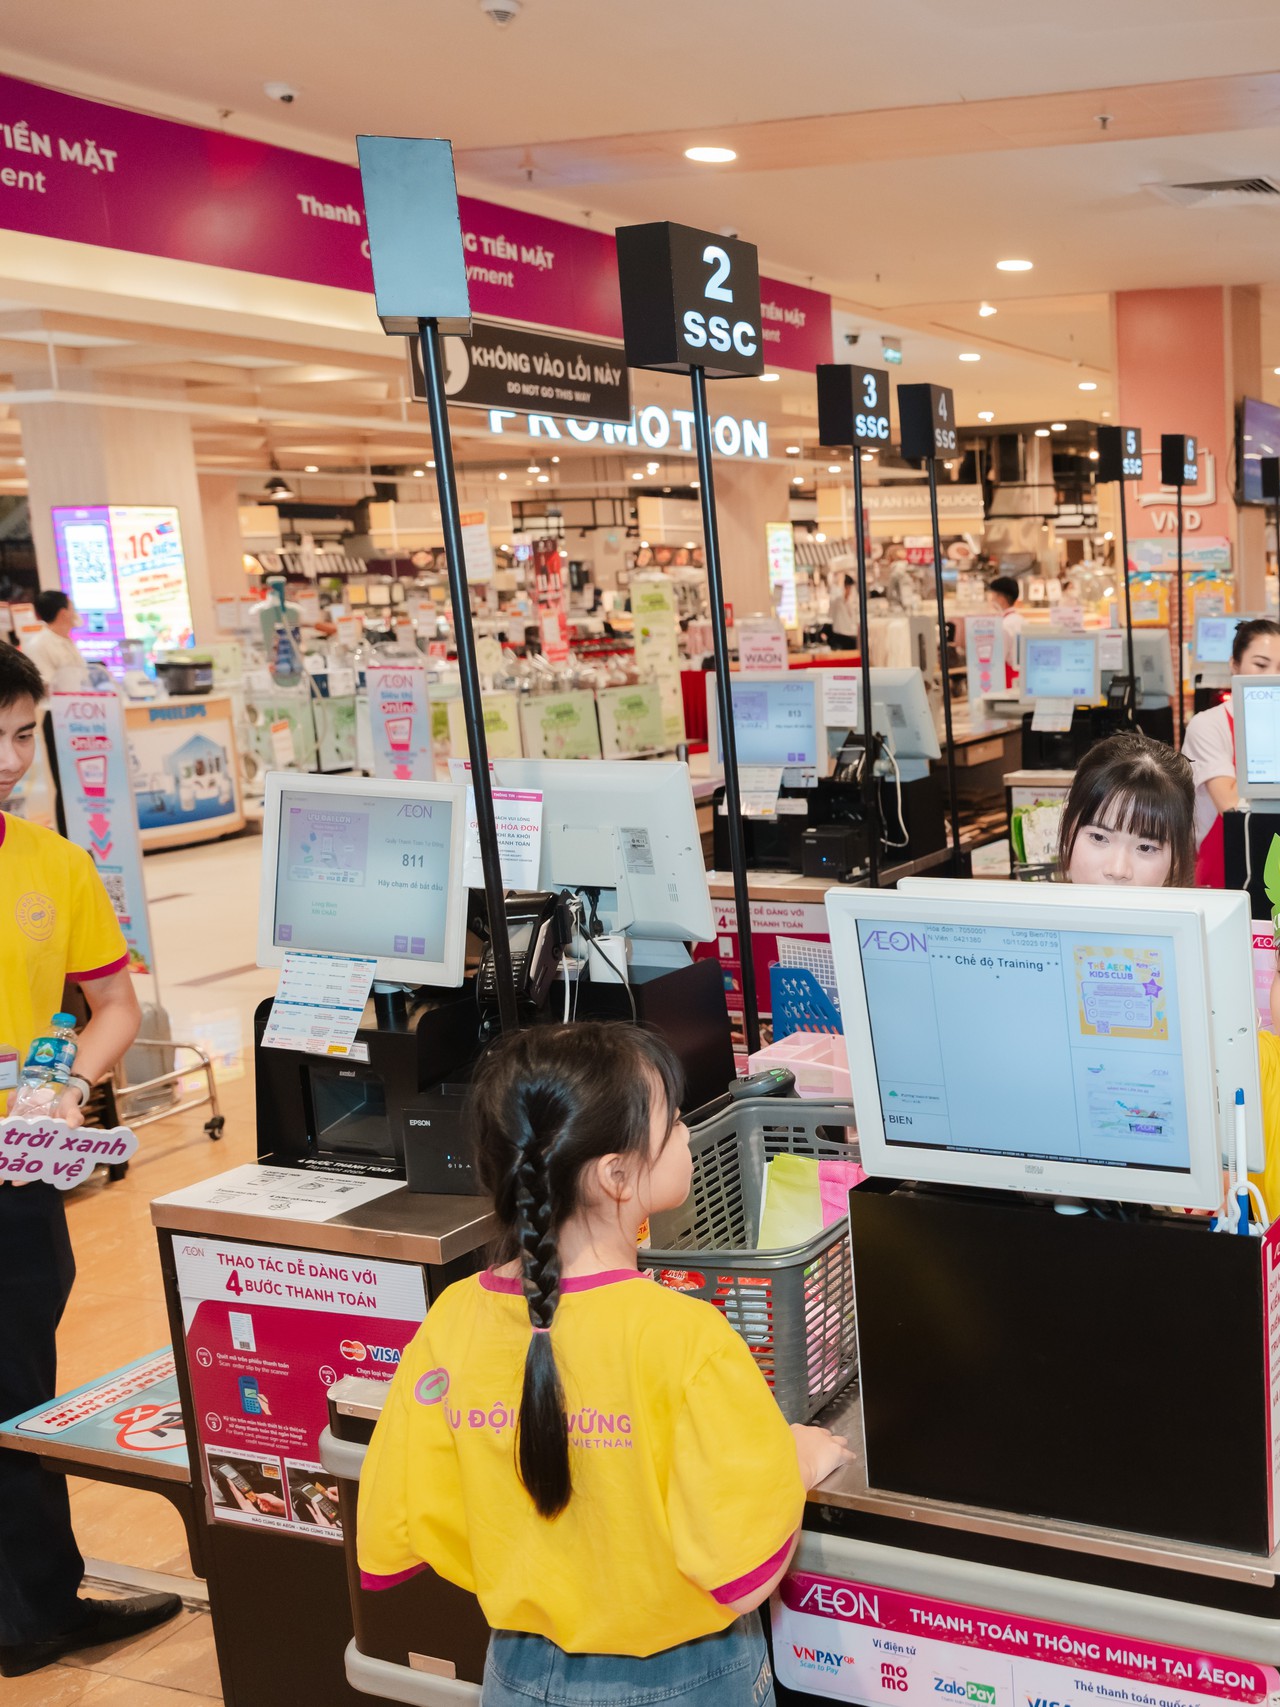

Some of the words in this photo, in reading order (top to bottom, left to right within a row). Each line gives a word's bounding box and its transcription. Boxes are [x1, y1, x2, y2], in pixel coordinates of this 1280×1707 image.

[58, 138, 117, 174] MẶT
[297, 194, 361, 226] Thanh
[521, 246, 555, 272] MẶT
[702, 245, 734, 303] 2
[683, 310, 757, 357] SSC
[471, 345, 530, 373] KHÔNG
[532, 350, 566, 379] VÀO
[862, 373, 878, 408] 3
[937, 392, 948, 422] 4
[855, 413, 889, 439] SSC
[934, 427, 956, 449] SSC
[1126, 430, 1136, 454] 5
[1122, 457, 1142, 475] SSC
[745, 654, 783, 664] WAON
[402, 853, 424, 869] 811
[717, 915, 728, 929] 4
[954, 953, 977, 966] Chế
[979, 956, 994, 969] độ
[997, 957, 1044, 973] Training
[1089, 970, 1110, 979] KIDS
[1110, 971, 1133, 980] CLUB
[1106, 962, 1132, 972] AEON
[408, 1119, 431, 1127] EPSON
[889, 1114, 914, 1126] BIEN
[3, 1127, 59, 1149] trời
[59, 1137, 128, 1156] xanh
[53, 1157, 85, 1182] vệ
[216, 1252, 255, 1269] THAO
[257, 1257, 284, 1273] TÁC
[286, 1258, 306, 1276] DỄ
[308, 1265, 349, 1282] DÀNG
[351, 1268, 378, 1286] VỚI
[225, 1268, 244, 1297] 4
[244, 1278, 283, 1296] BƯỚC
[284, 1284, 335, 1303] THANH
[336, 1290, 378, 1310] TOÁN
[366, 1345, 401, 1363] VISA
[467, 1400, 515, 1435] ĐỘI
[567, 1408, 632, 1434] VỮNG
[571, 1437, 634, 1449] VIETNAM
[793, 1645, 844, 1667] VNPAY
[872, 1638, 884, 1649] Ví
[884, 1640, 904, 1654] điện
[905, 1645, 917, 1655] tử
[909, 1607, 973, 1635] THANH
[976, 1621, 1029, 1645] TOÁN
[1033, 1632, 1100, 1659] THÔNG
[1105, 1646, 1158, 1673] MINH
[1161, 1657, 1194, 1680] TẠI
[1197, 1665, 1256, 1692] AEON
[799, 1659, 816, 1670] Scan
[817, 1663, 825, 1672] to
[826, 1665, 839, 1676] Pay
[880, 1662, 908, 1678] mo
[881, 1675, 909, 1693] mo
[1073, 1679, 1094, 1693] Thẻ
[1096, 1683, 1129, 1701] thanh
[1131, 1691, 1157, 1706] toán
